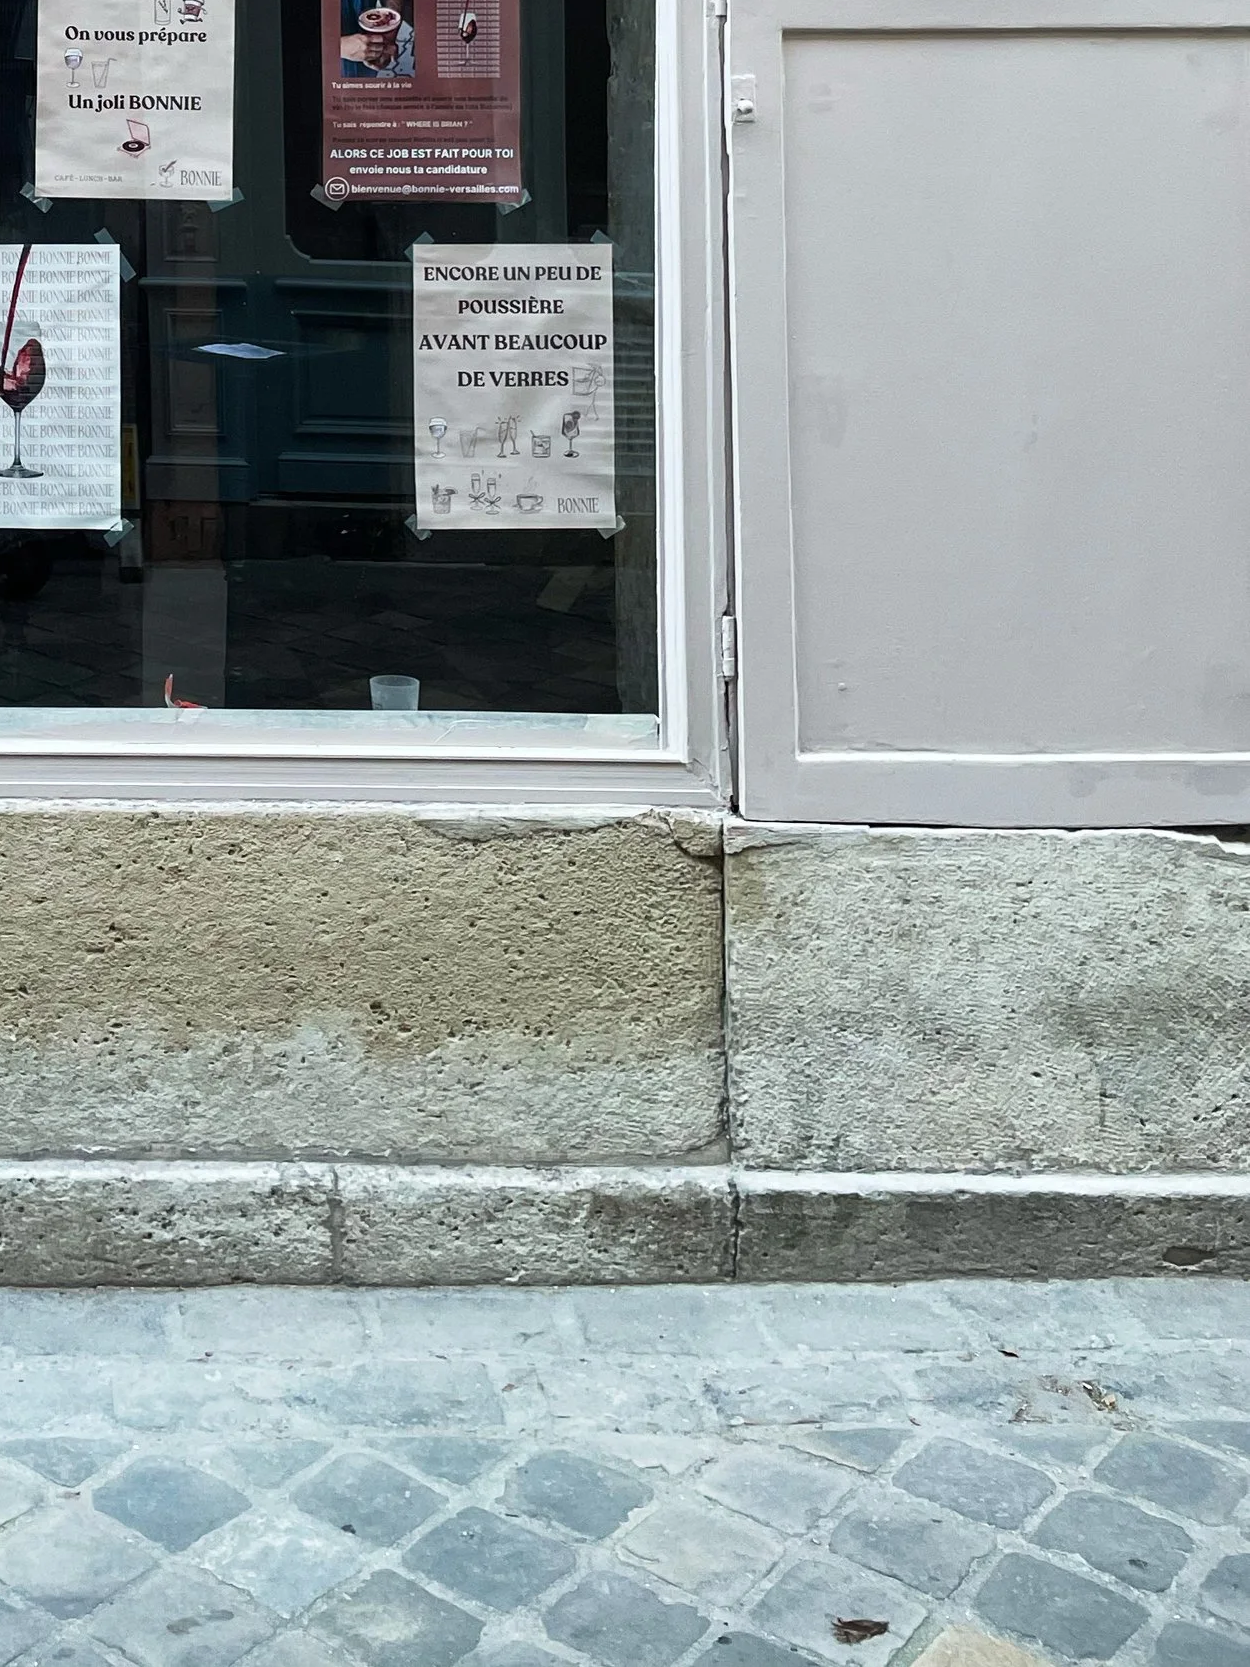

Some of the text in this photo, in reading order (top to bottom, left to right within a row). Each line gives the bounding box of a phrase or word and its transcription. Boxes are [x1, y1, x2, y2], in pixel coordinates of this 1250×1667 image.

[65, 26, 207, 46] On vous prépare
[69, 95, 202, 112] Un joli BONNIE
[330, 148, 513, 158] ALORS CE JOB EST FAIT POUR TOI
[350, 165, 488, 174] envoie nous ta candidature
[181, 170, 222, 186] BONNIE
[424, 266, 601, 281] ENCORE UN PEU DE
[458, 296, 564, 314] POUSSIÈRE
[419, 335, 607, 350] AVANT BEAUCOUP
[458, 371, 569, 386] DE VERRES
[558, 498, 599, 514] BONNIE
